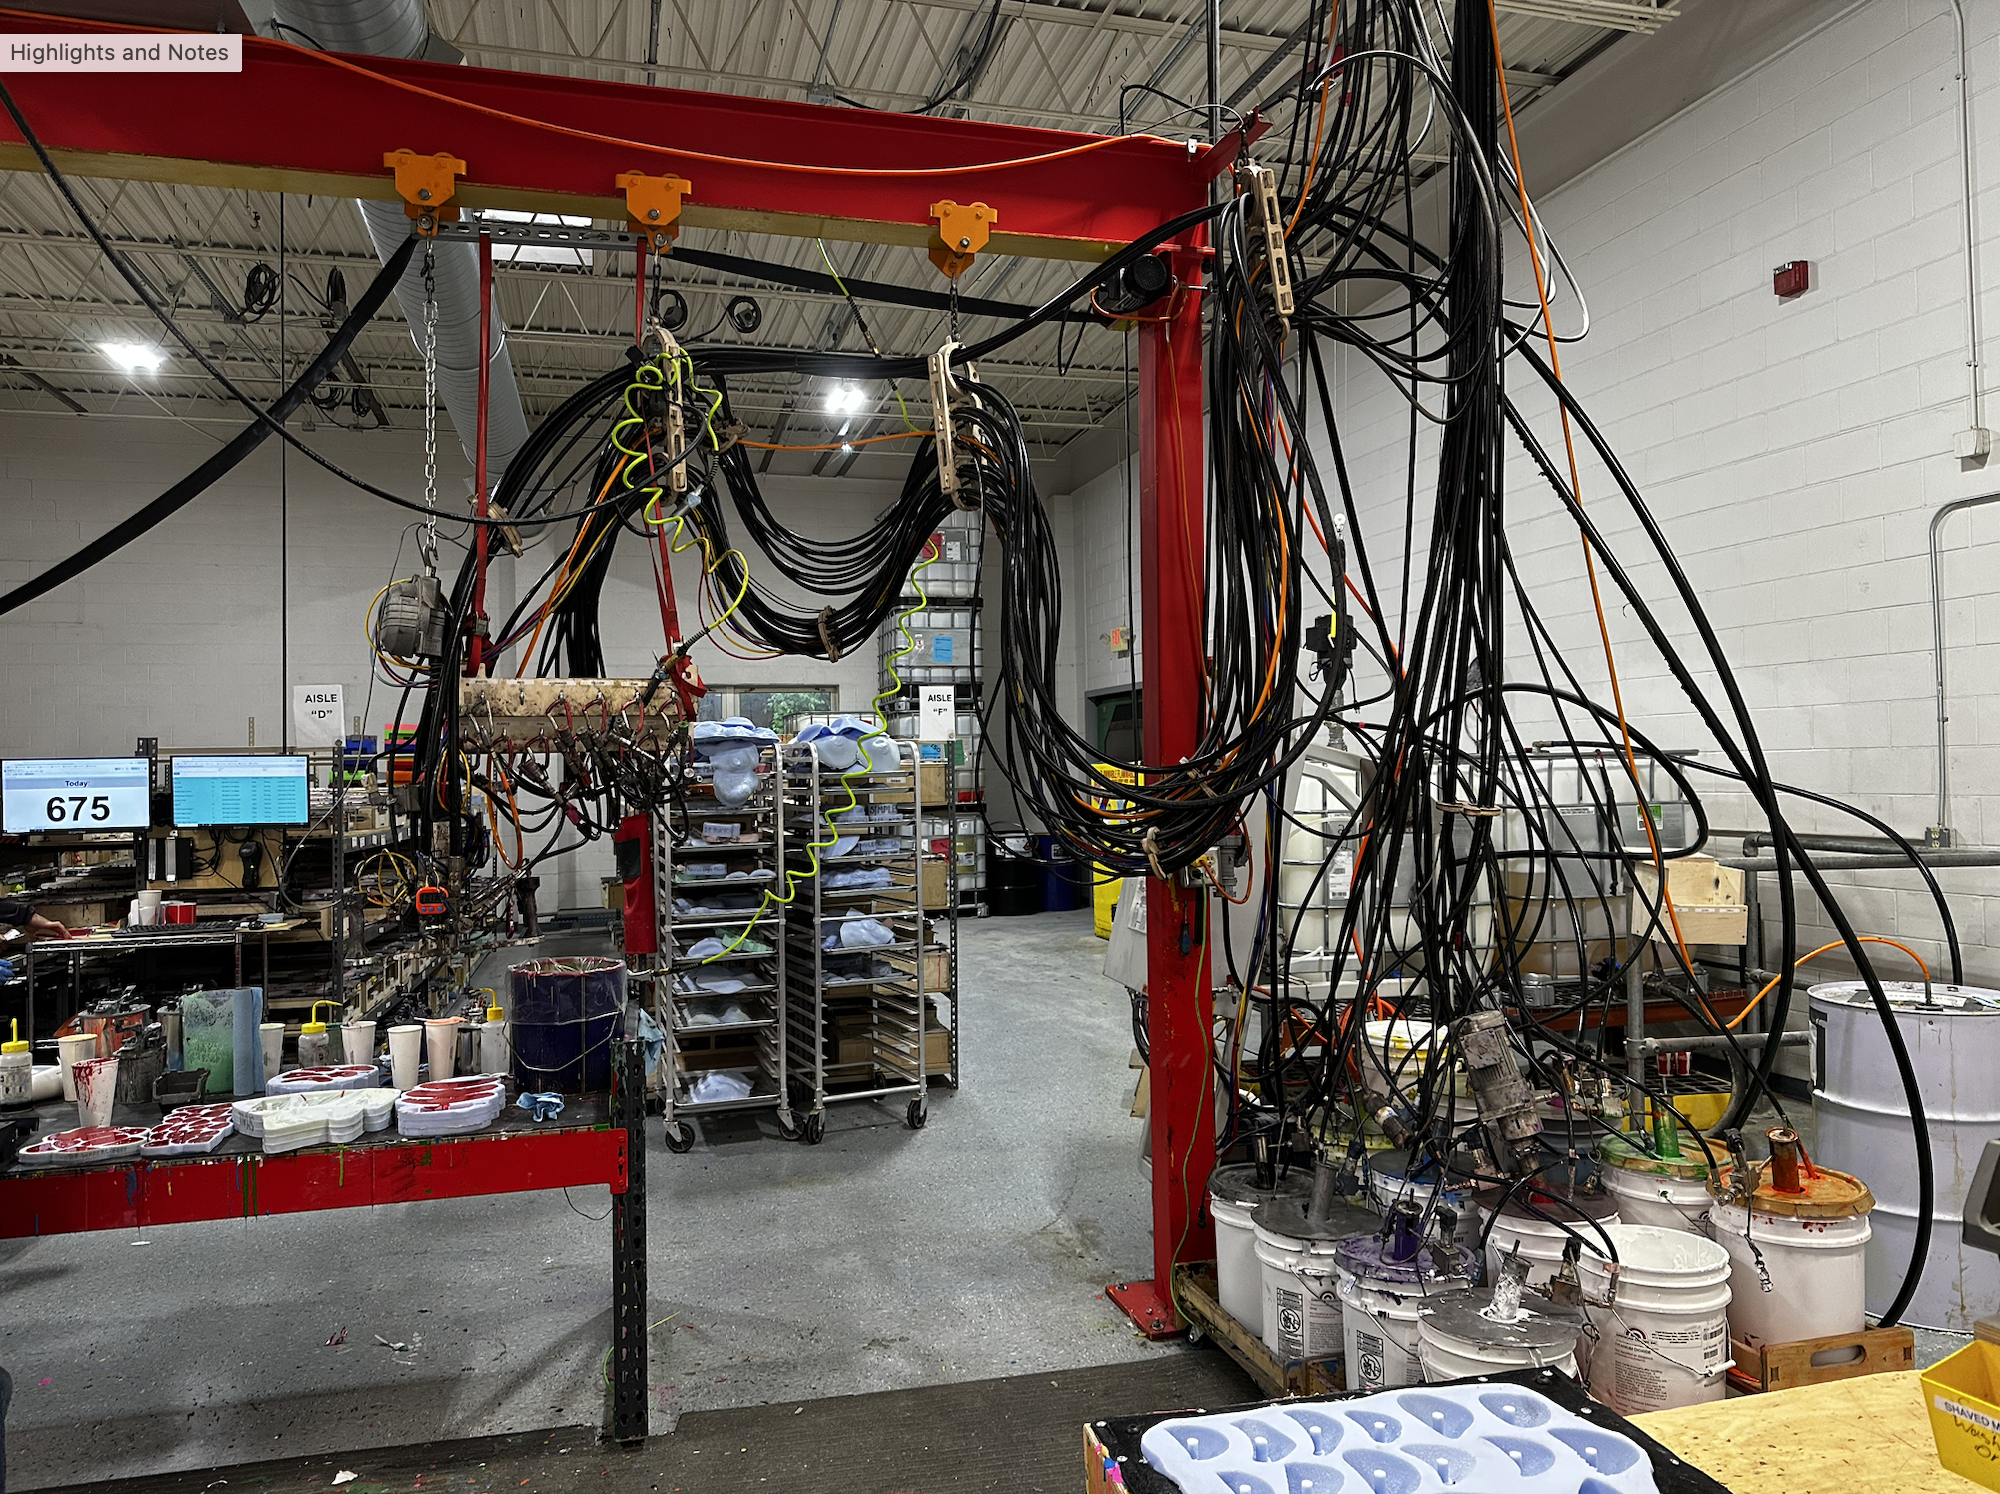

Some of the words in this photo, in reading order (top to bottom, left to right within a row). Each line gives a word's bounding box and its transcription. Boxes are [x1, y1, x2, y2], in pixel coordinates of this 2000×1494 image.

[305, 694, 337, 703] AISLE
[928, 694, 952, 702] AISLE
[46, 796, 110, 822] 675
[1944, 1401, 1990, 1427] SHAVED
